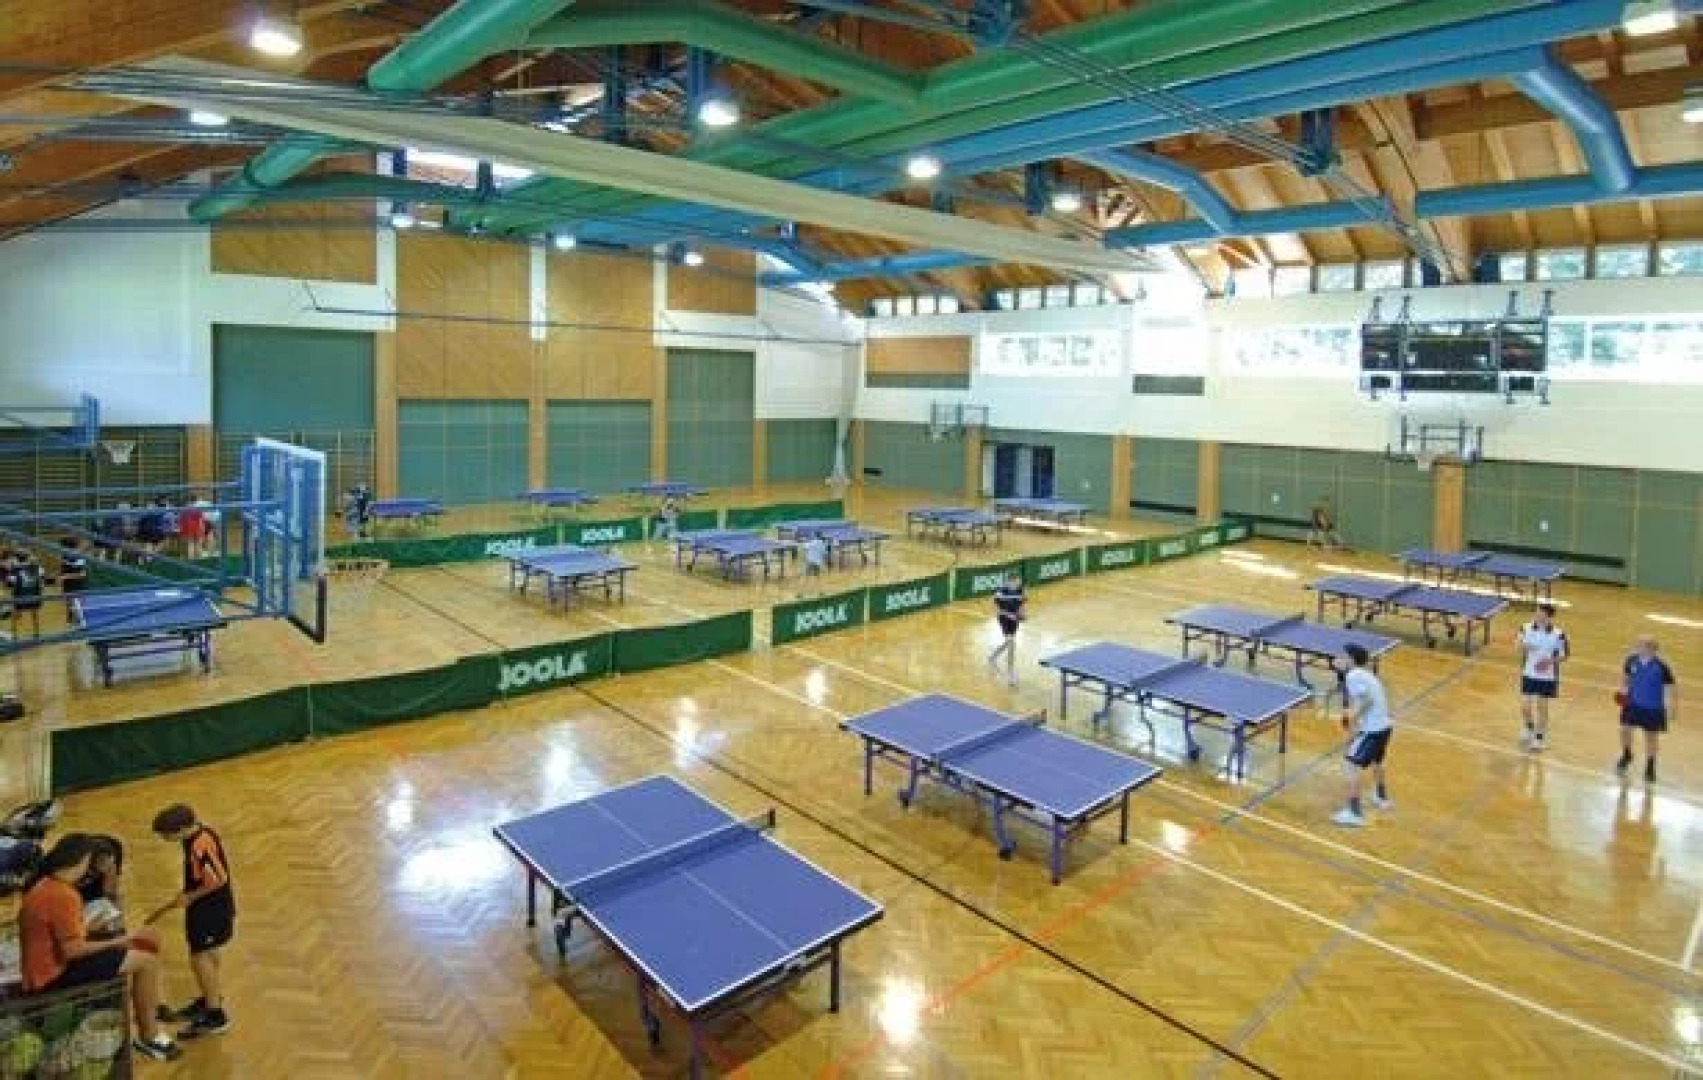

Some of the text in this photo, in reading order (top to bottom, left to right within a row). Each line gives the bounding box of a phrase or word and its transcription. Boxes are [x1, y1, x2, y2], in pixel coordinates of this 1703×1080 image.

[886, 586, 931, 612] JOOLA
[795, 603, 848, 632] JOOLA
[498, 651, 587, 690] JOOLA
